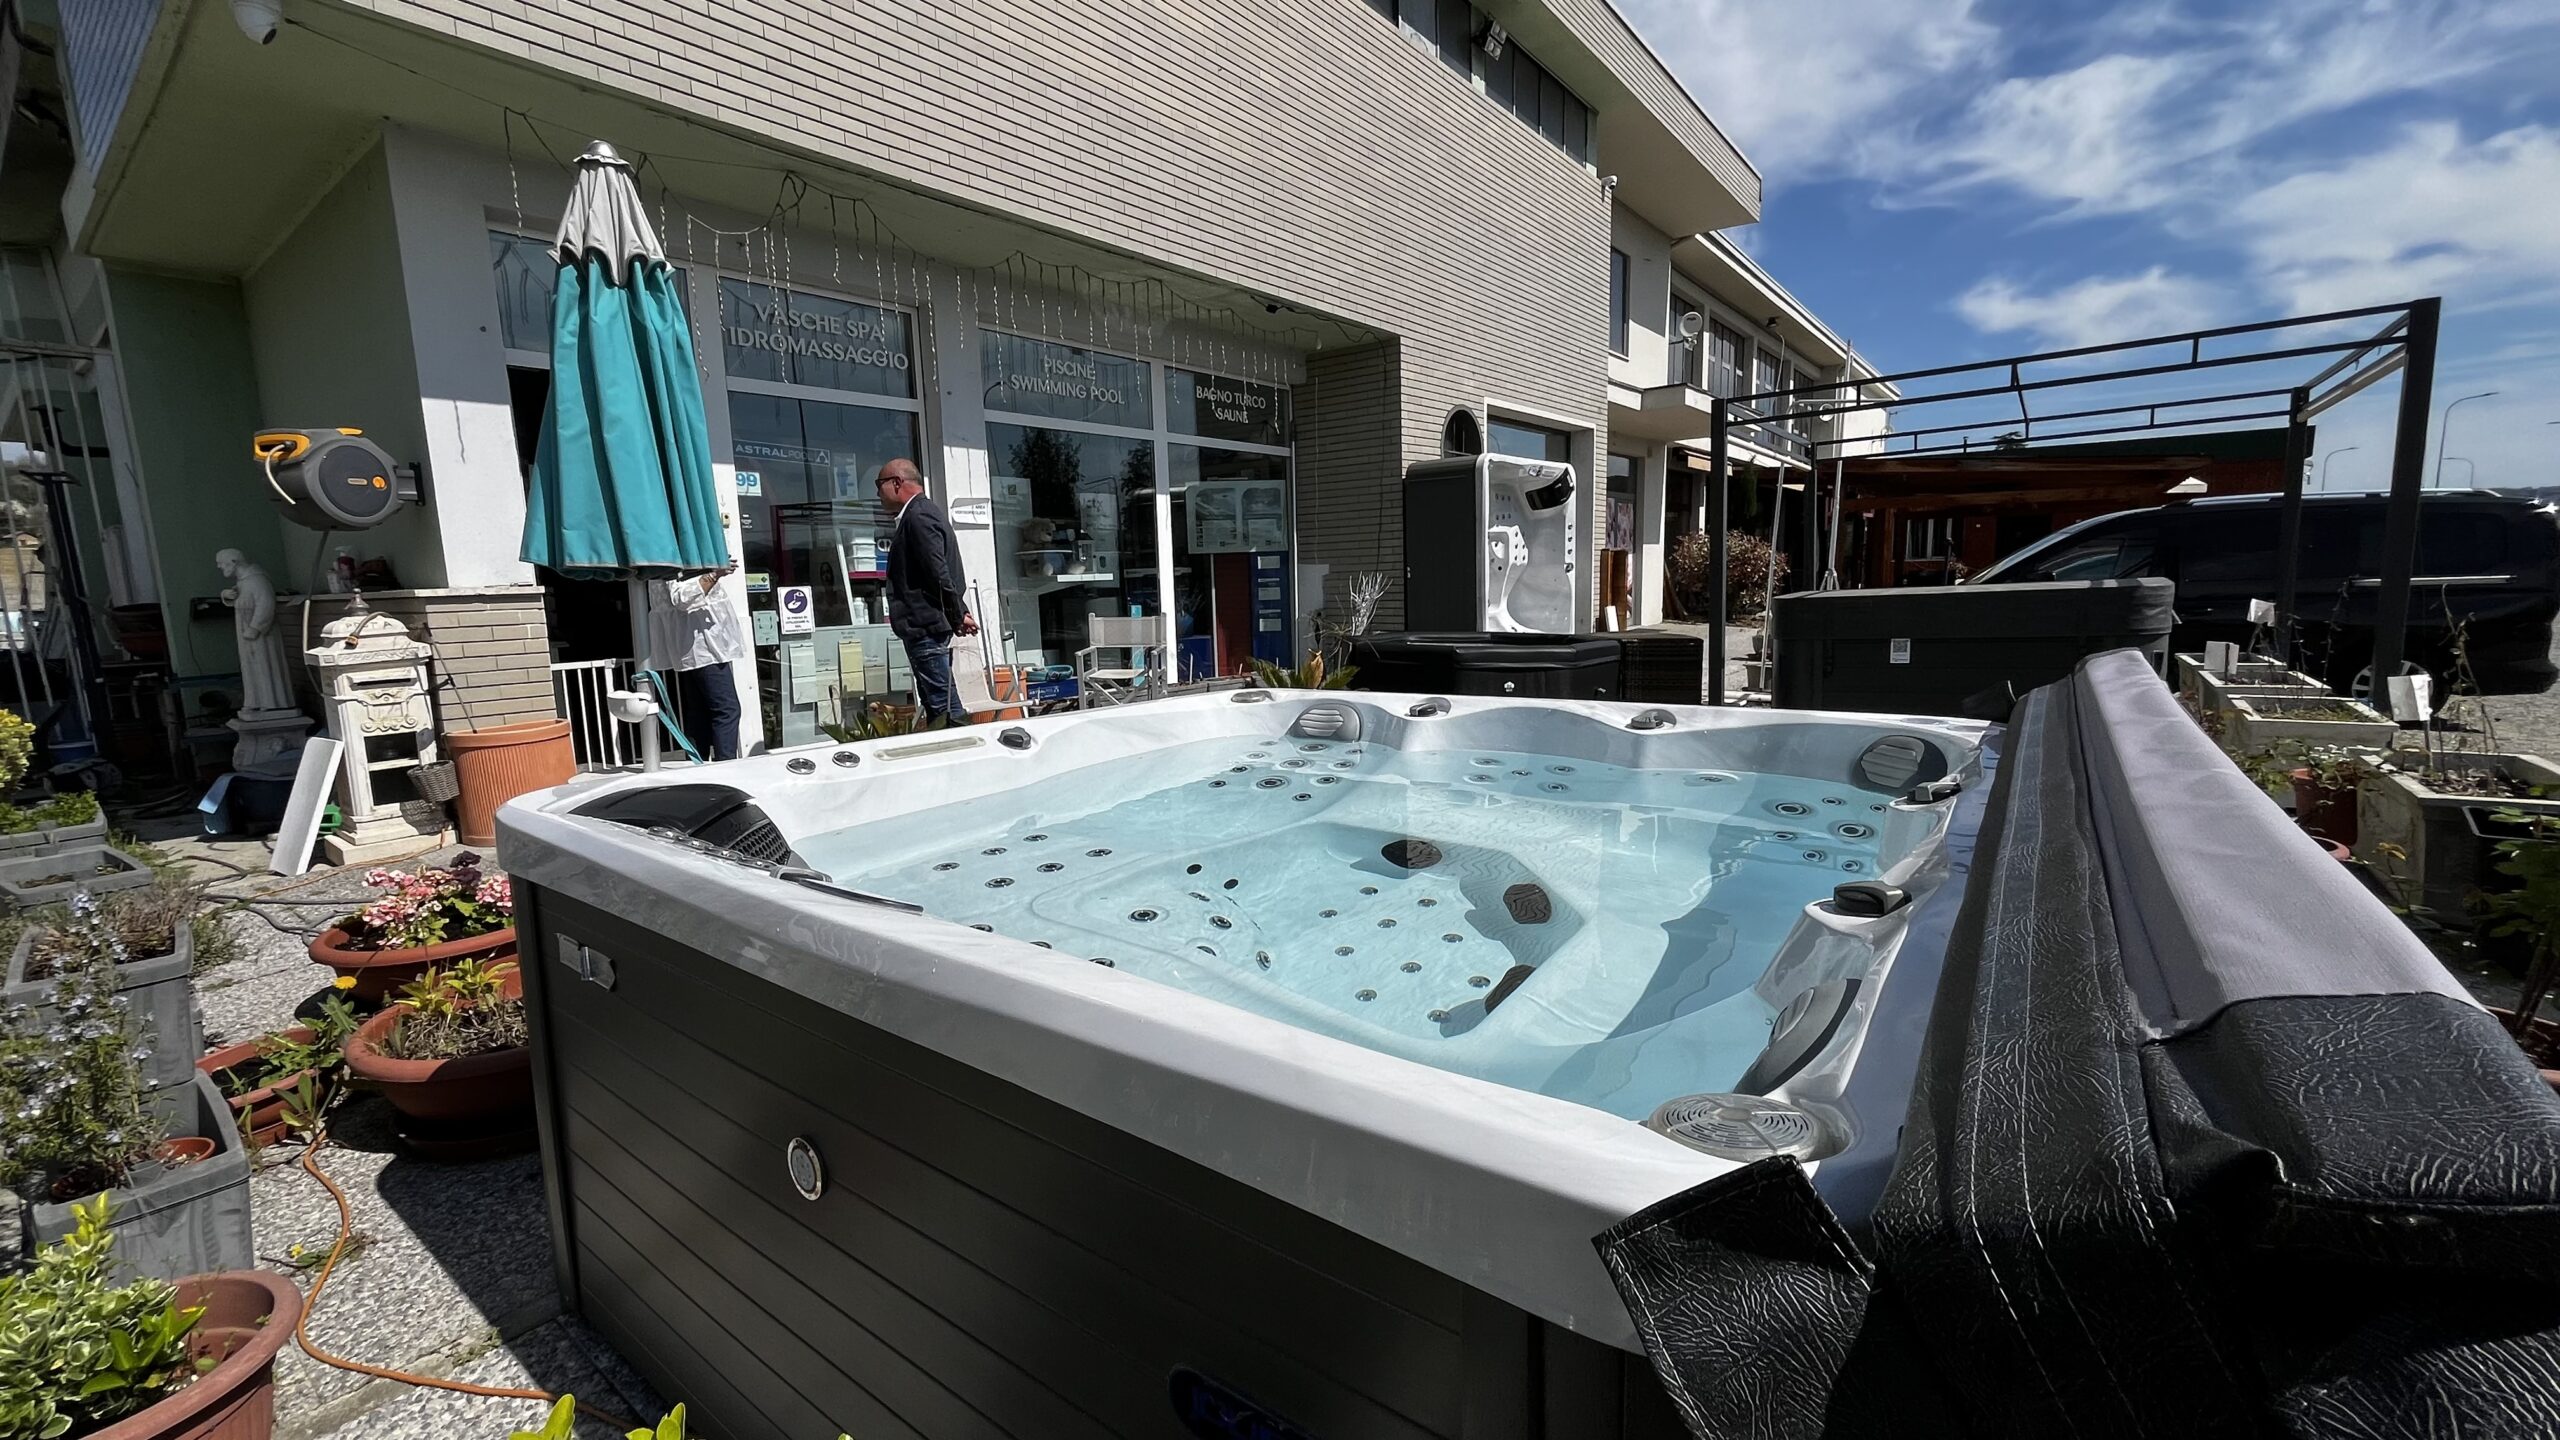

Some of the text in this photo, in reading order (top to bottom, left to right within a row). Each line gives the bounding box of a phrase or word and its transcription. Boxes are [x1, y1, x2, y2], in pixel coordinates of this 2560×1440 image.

[754, 303, 884, 343] VASCHE SPA
[729, 326, 909, 371] IDROMASSAGGIO
[1044, 357, 1096, 380] PISCINE
[1010, 373, 1125, 405] SWIMMING POOL
[1195, 385, 1267, 410] BAGNO TURCO
[1217, 407, 1249, 424] SAUNE
